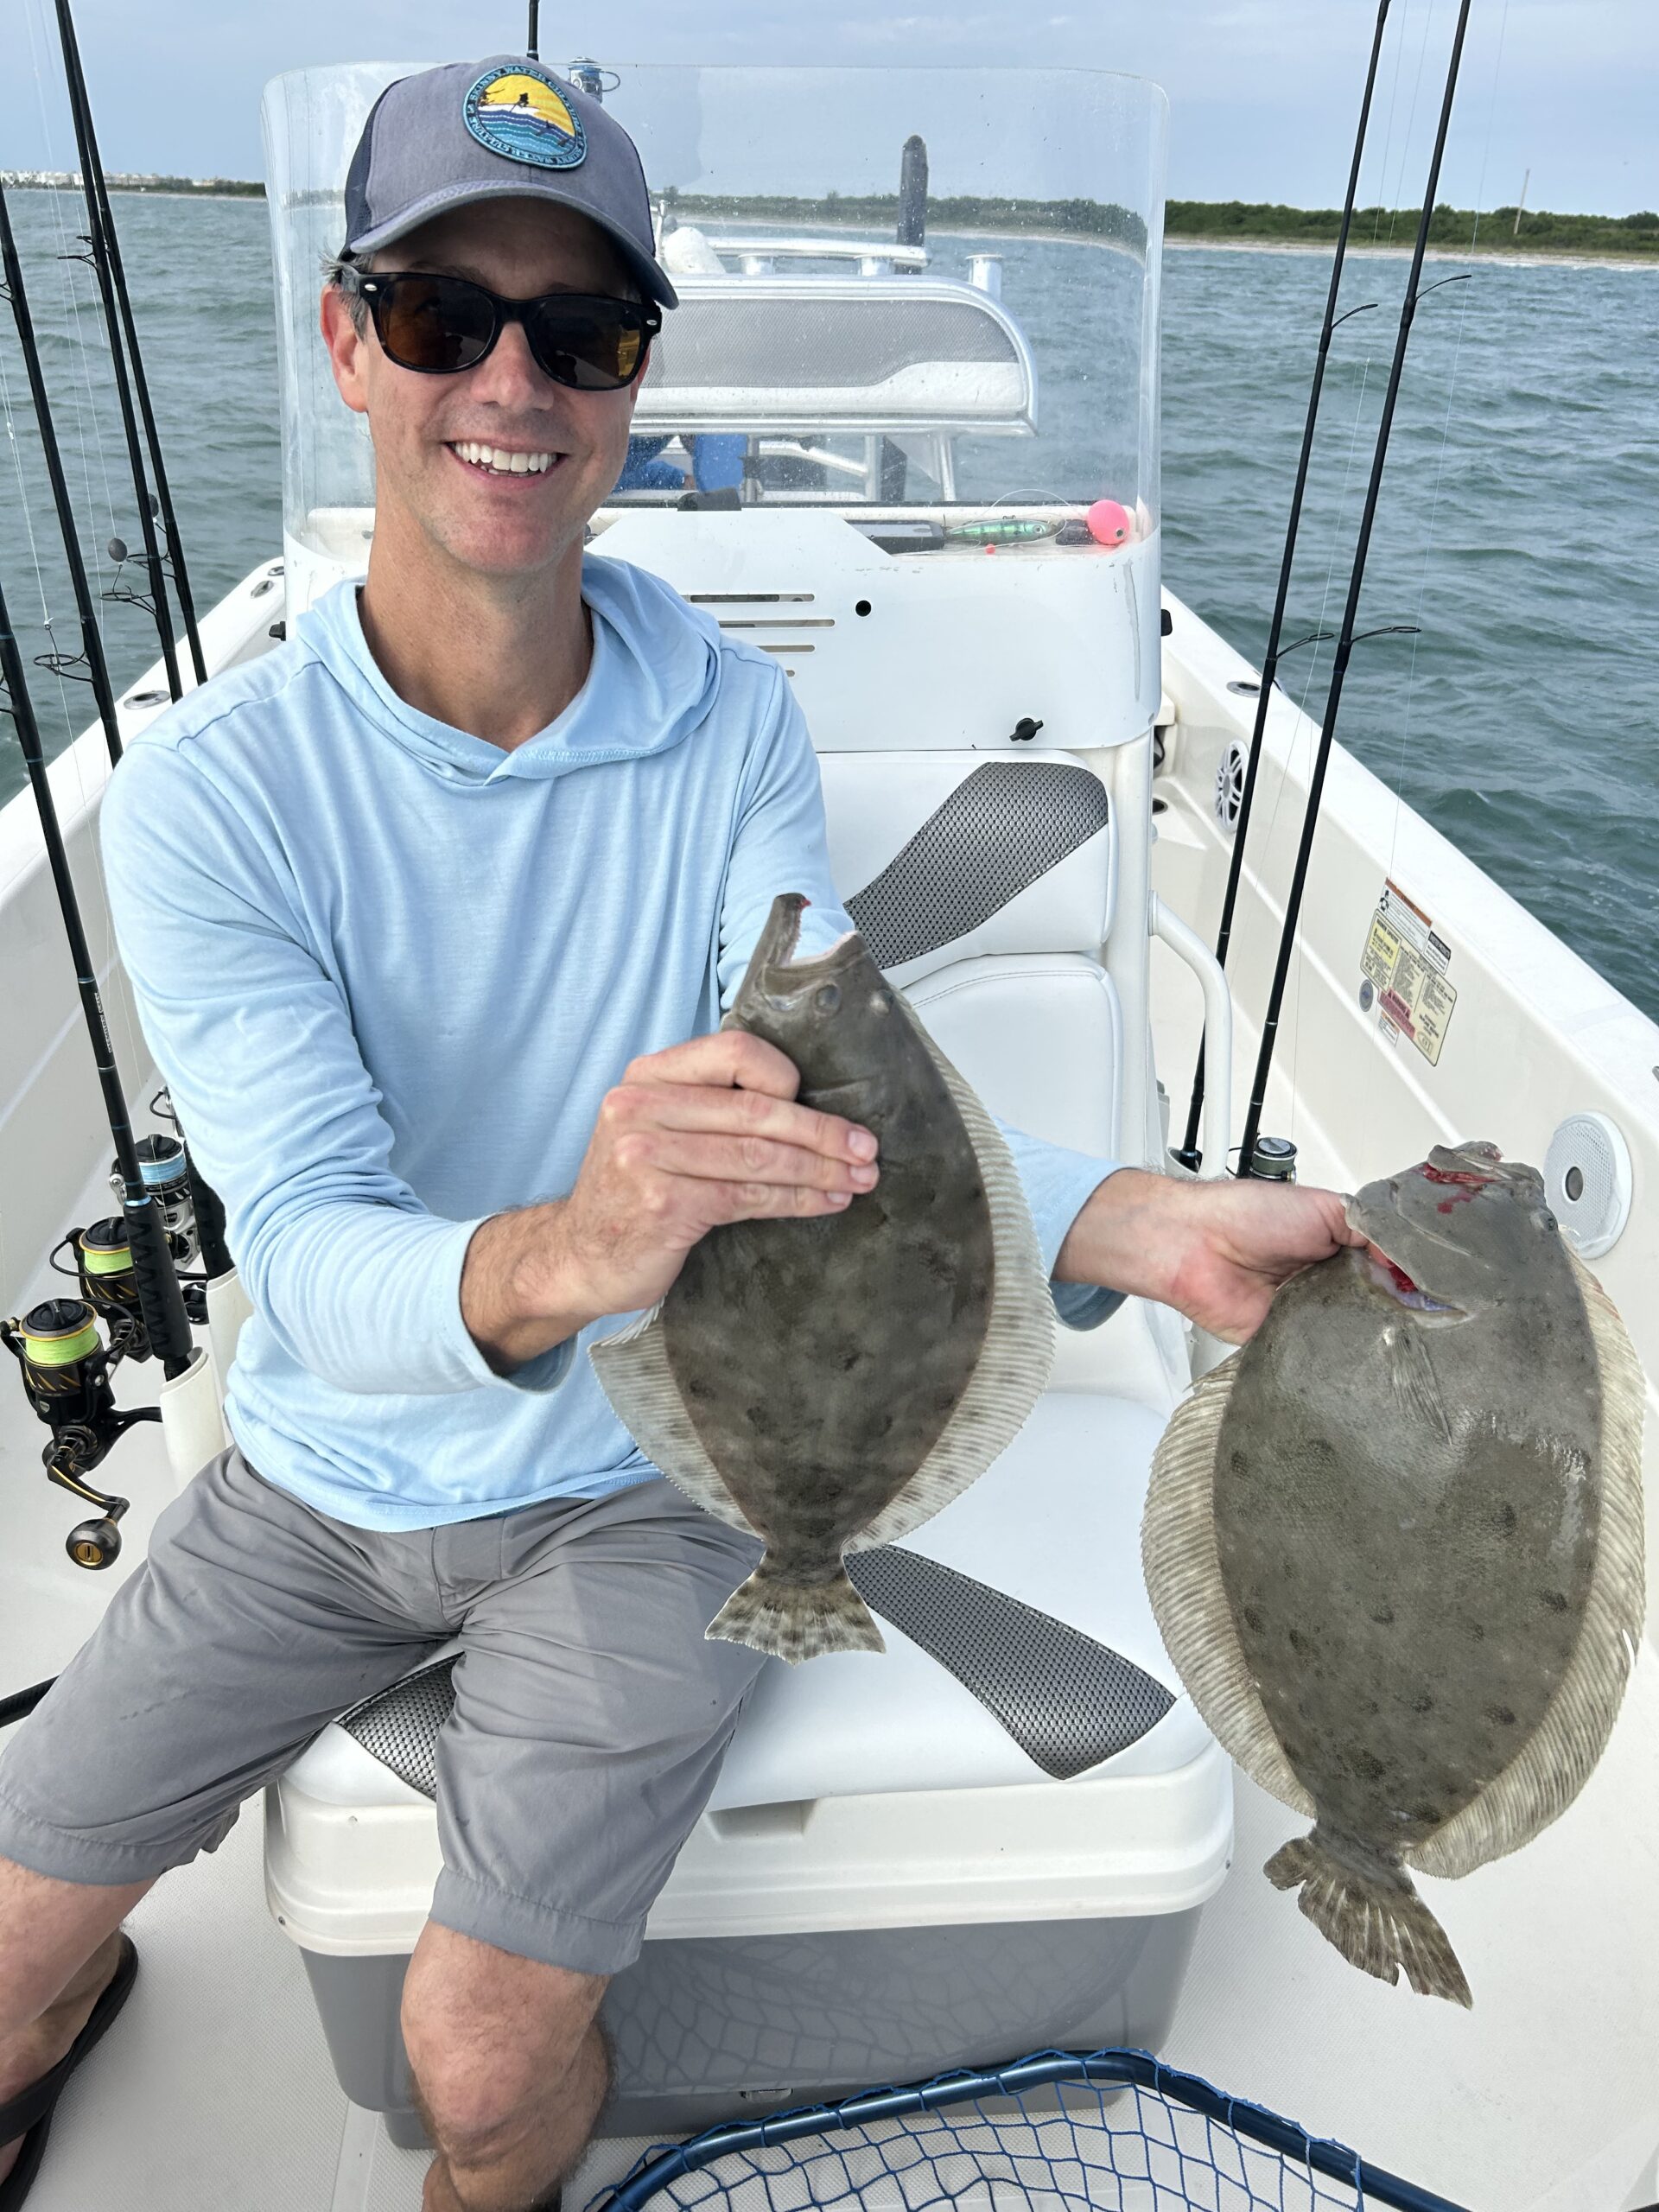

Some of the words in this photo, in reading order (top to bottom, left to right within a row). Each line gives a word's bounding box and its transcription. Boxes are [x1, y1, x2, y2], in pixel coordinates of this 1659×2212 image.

[471, 71, 502, 101] SKINNY
[504, 65, 547, 83] WATER
[468, 116, 511, 153] CULTURE
